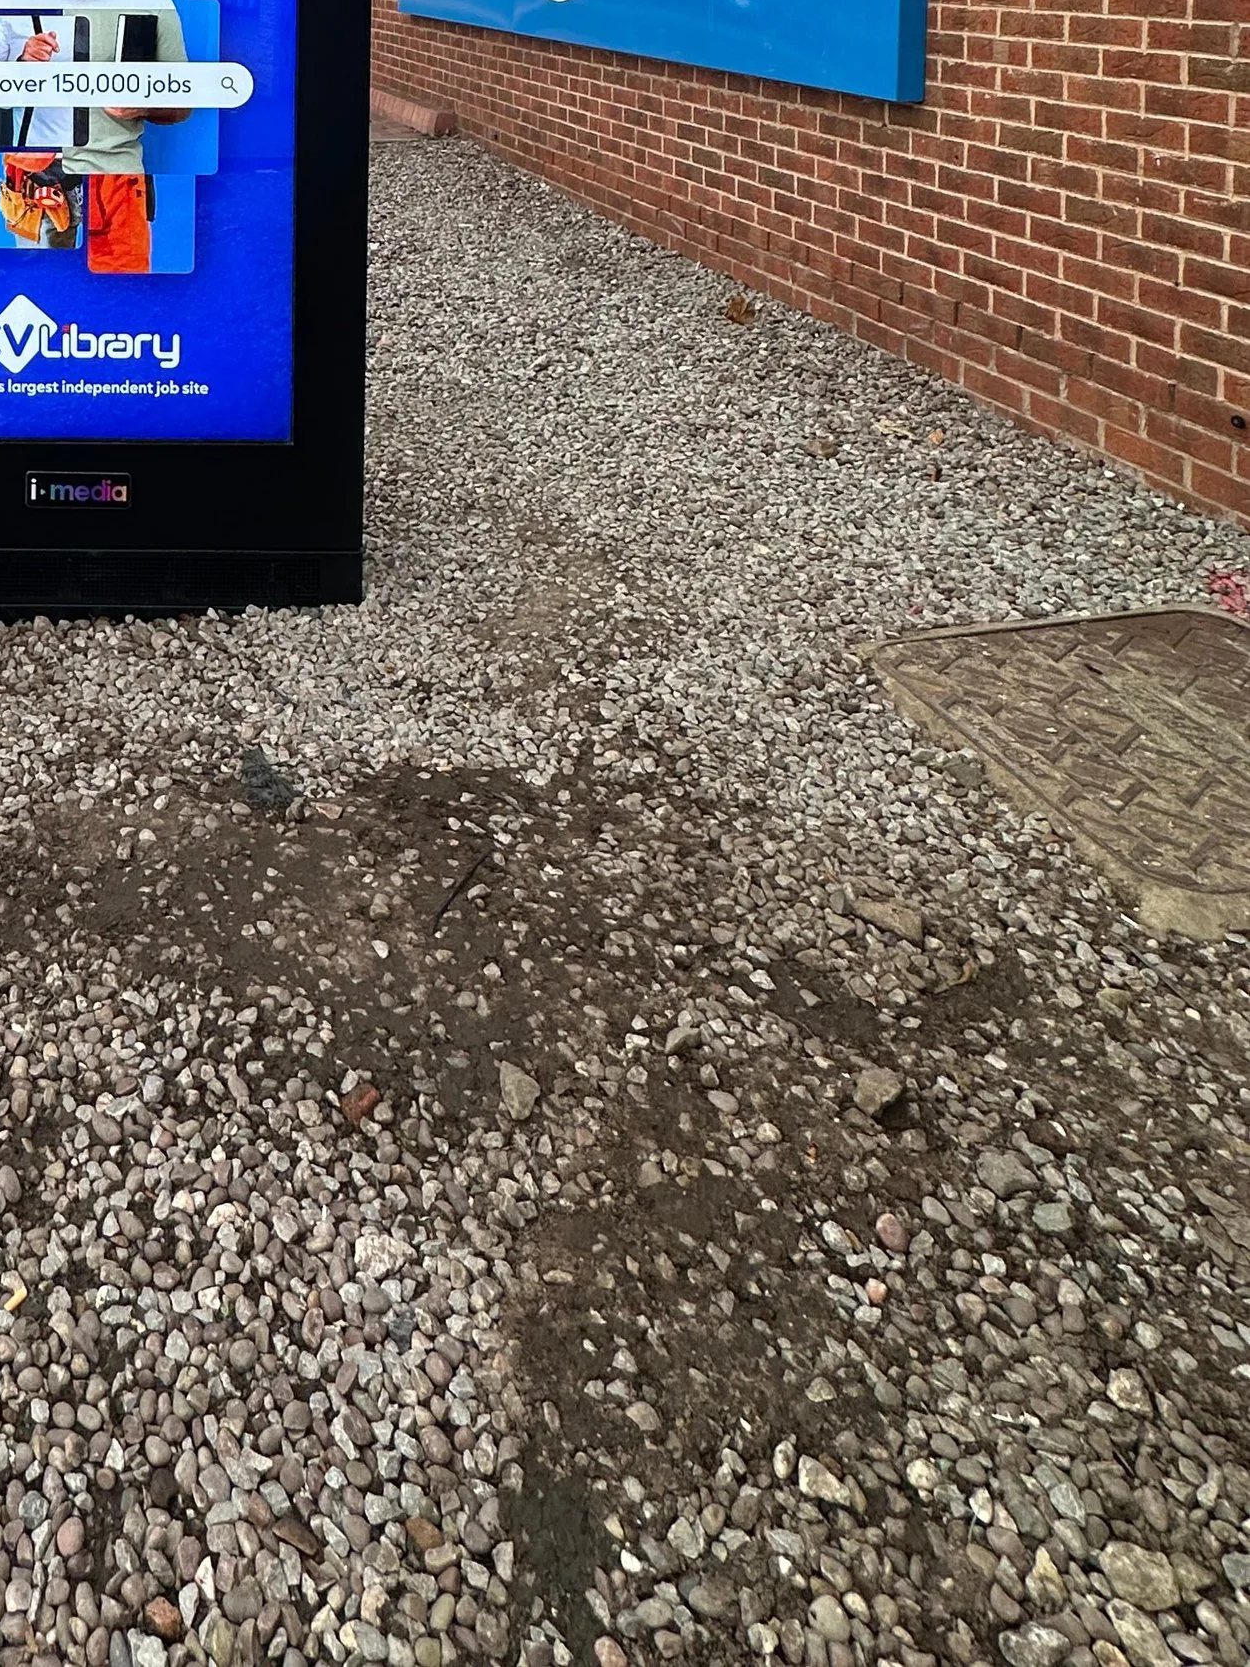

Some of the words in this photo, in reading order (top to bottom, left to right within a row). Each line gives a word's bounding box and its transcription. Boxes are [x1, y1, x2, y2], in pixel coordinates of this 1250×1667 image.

[0, 77, 47, 93] over
[51, 73, 140, 97] 150,000
[144, 74, 192, 98] jobs
[7, 379, 59, 396] largest
[62, 380, 154, 396] independent
[154, 380, 180, 397] job
[182, 380, 209, 395] site
